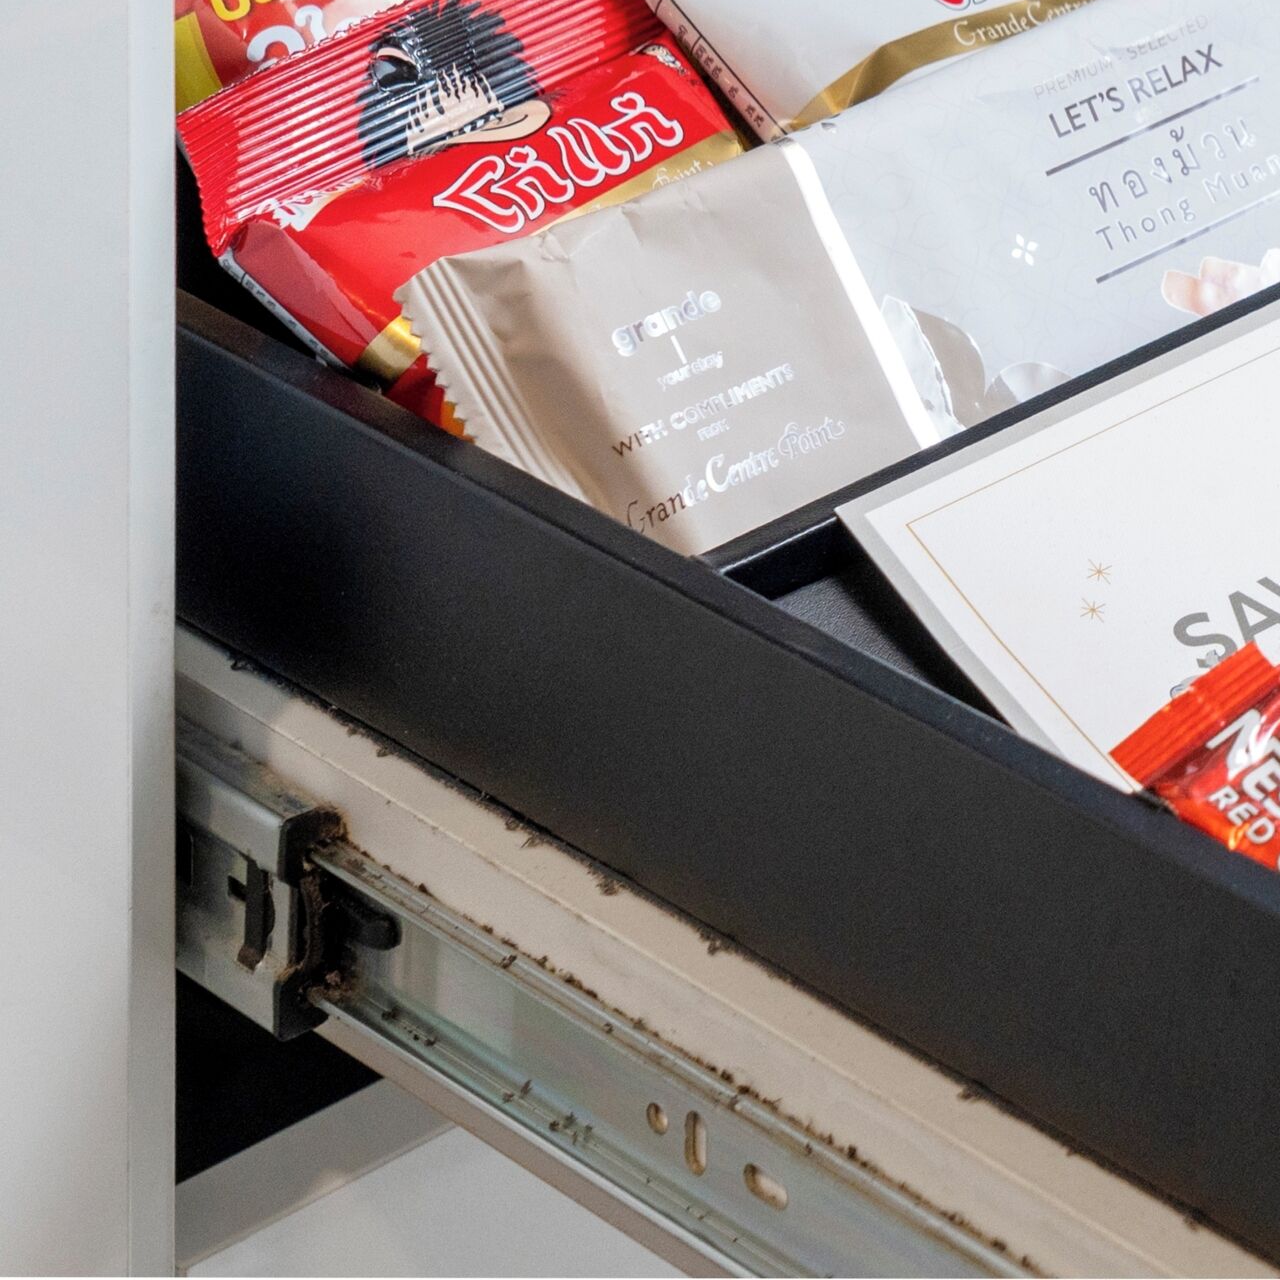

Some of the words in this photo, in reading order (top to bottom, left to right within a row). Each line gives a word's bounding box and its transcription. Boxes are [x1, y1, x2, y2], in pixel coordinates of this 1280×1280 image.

[954, 9, 1028, 47] Grande
[1048, 86, 1125, 139] LET'S
[1127, 43, 1223, 104] RELAX
[1095, 197, 1197, 251] Thong
[611, 290, 722, 357] grande
[611, 418, 668, 458] WITH
[669, 362, 795, 431] COMPLIMENTS
[705, 446, 780, 493] Centre
[1208, 785, 1276, 844] RED
